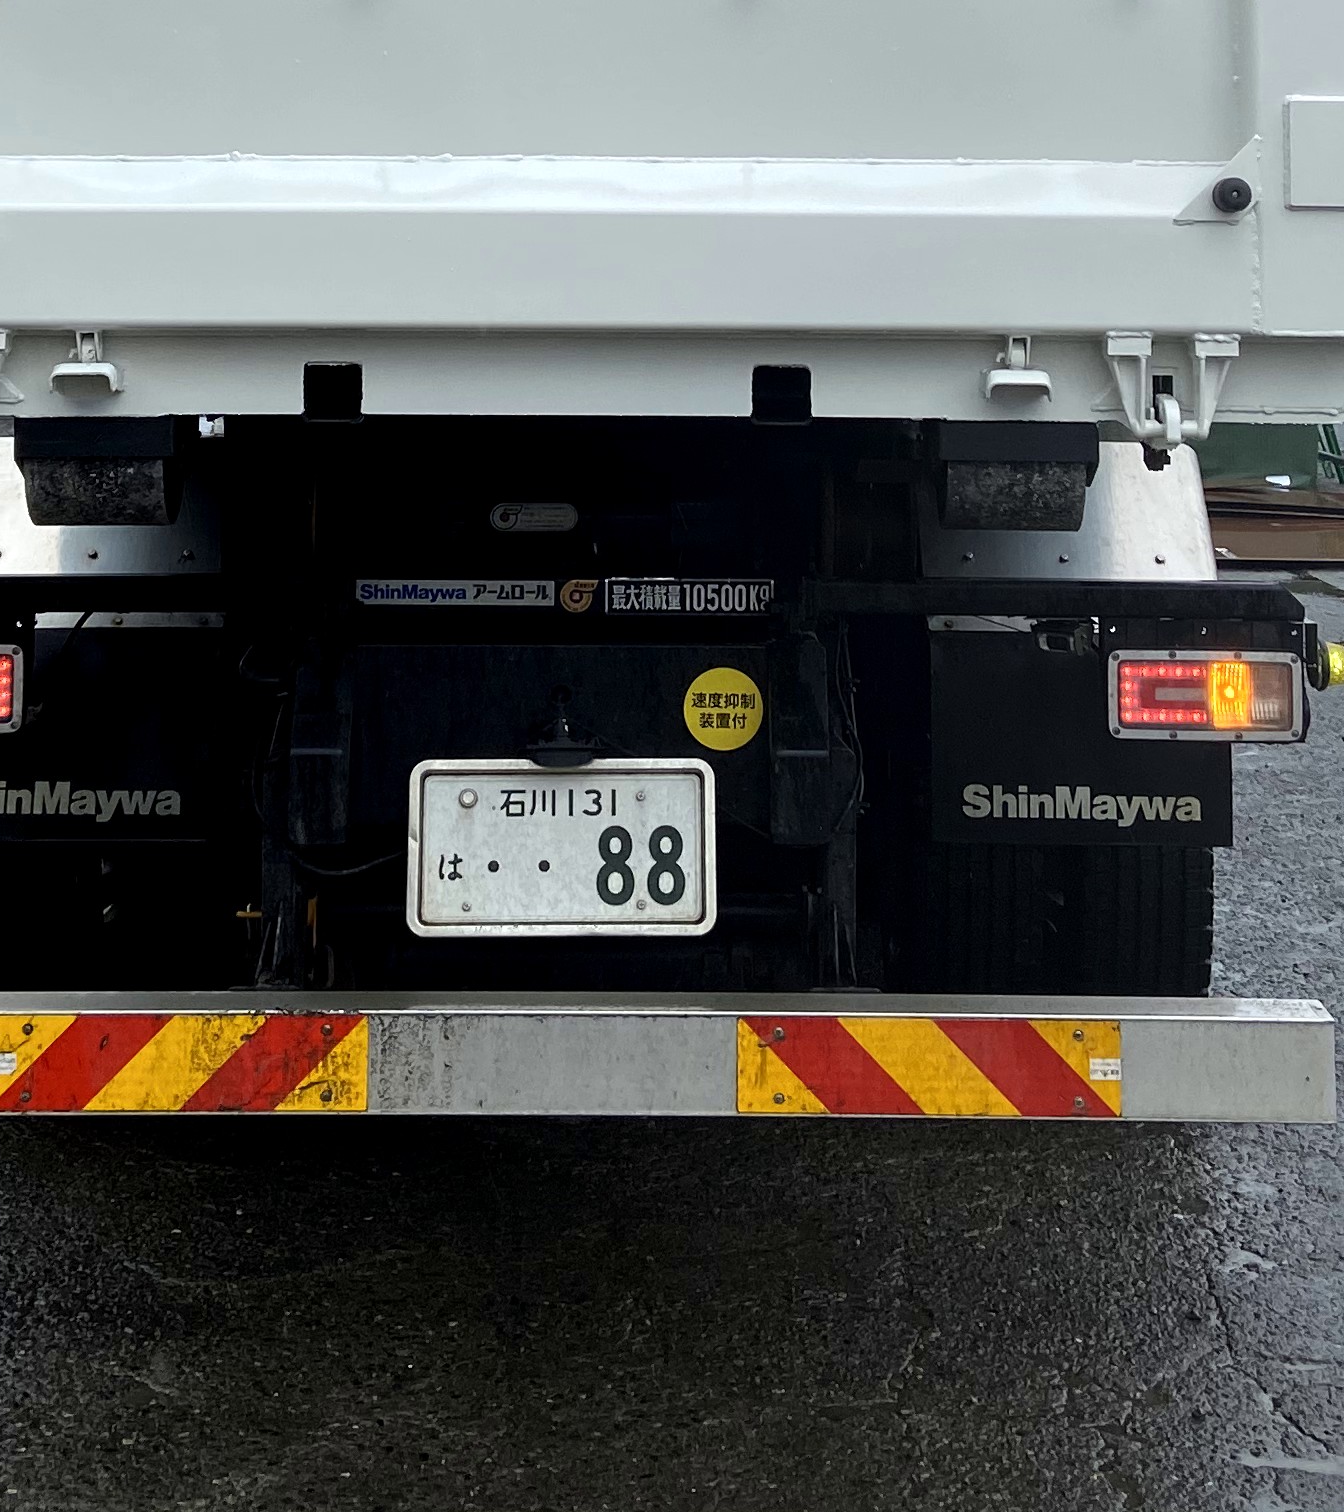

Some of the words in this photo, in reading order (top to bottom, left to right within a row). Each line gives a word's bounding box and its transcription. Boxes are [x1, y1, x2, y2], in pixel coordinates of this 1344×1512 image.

[359, 583, 467, 603] ShinMaywa
[472, 584, 549, 600] アームロール
[691, 692, 756, 709] 速度抑制
[699, 712, 748, 730] 装置付
[962, 783, 1202, 827] ShinMaywa
